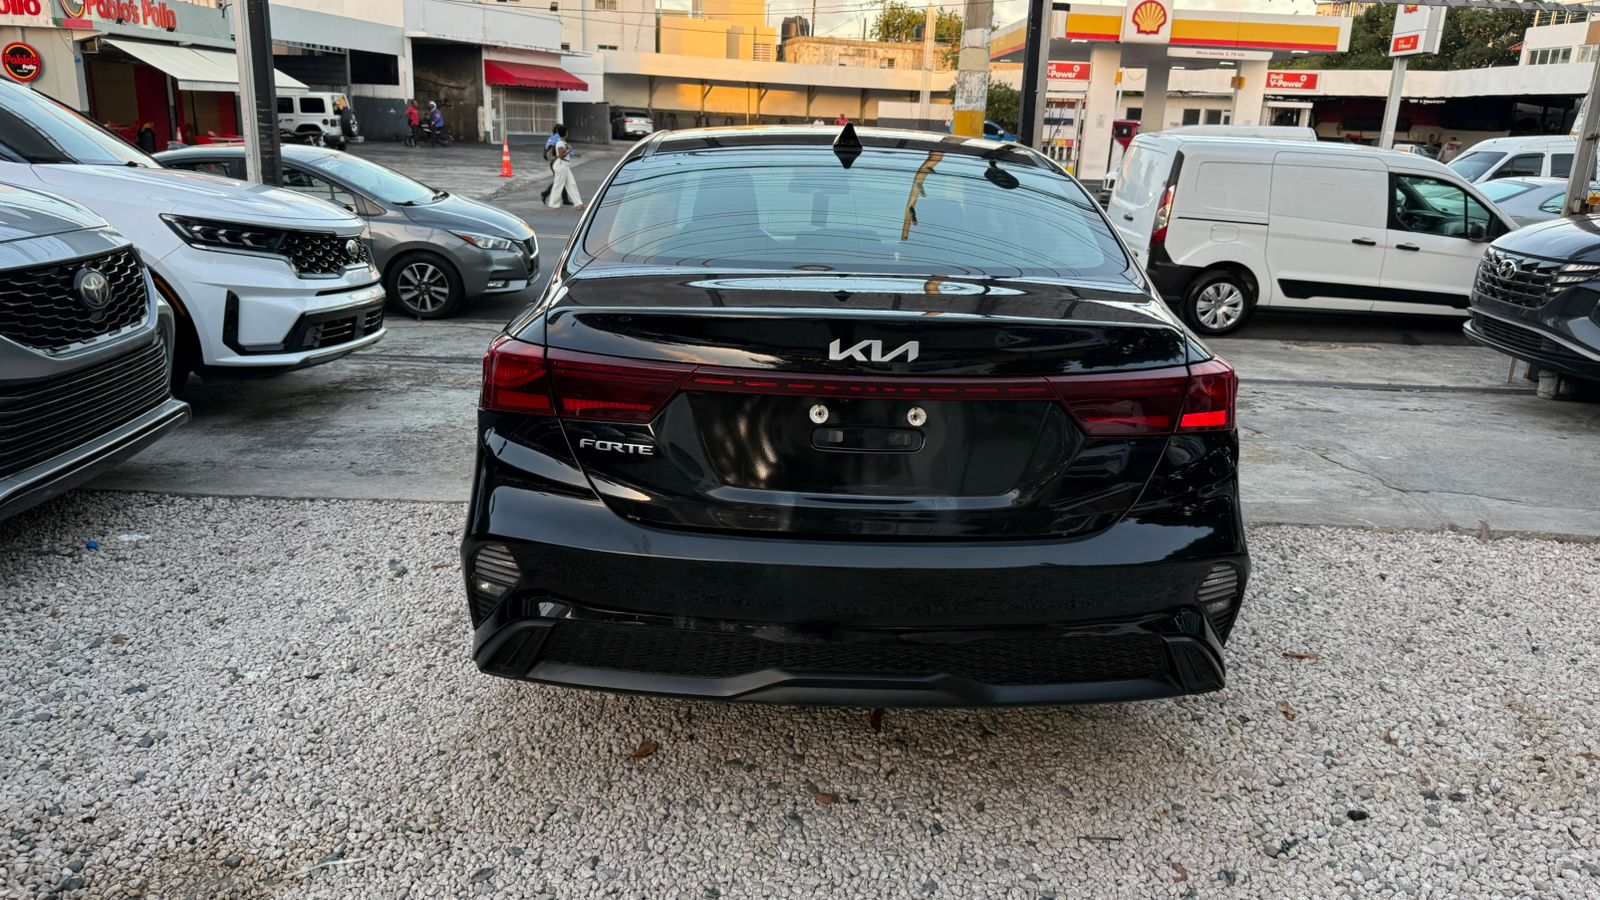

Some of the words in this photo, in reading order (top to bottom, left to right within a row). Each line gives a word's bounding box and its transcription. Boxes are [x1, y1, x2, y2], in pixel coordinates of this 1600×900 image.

[87, 0, 140, 24] Pablo's
[142, 0, 177, 29] Pollo
[1270, 79, 1304, 88] V-Power
[829, 338, 919, 362] KIA
[579, 438, 654, 456] FORTE
